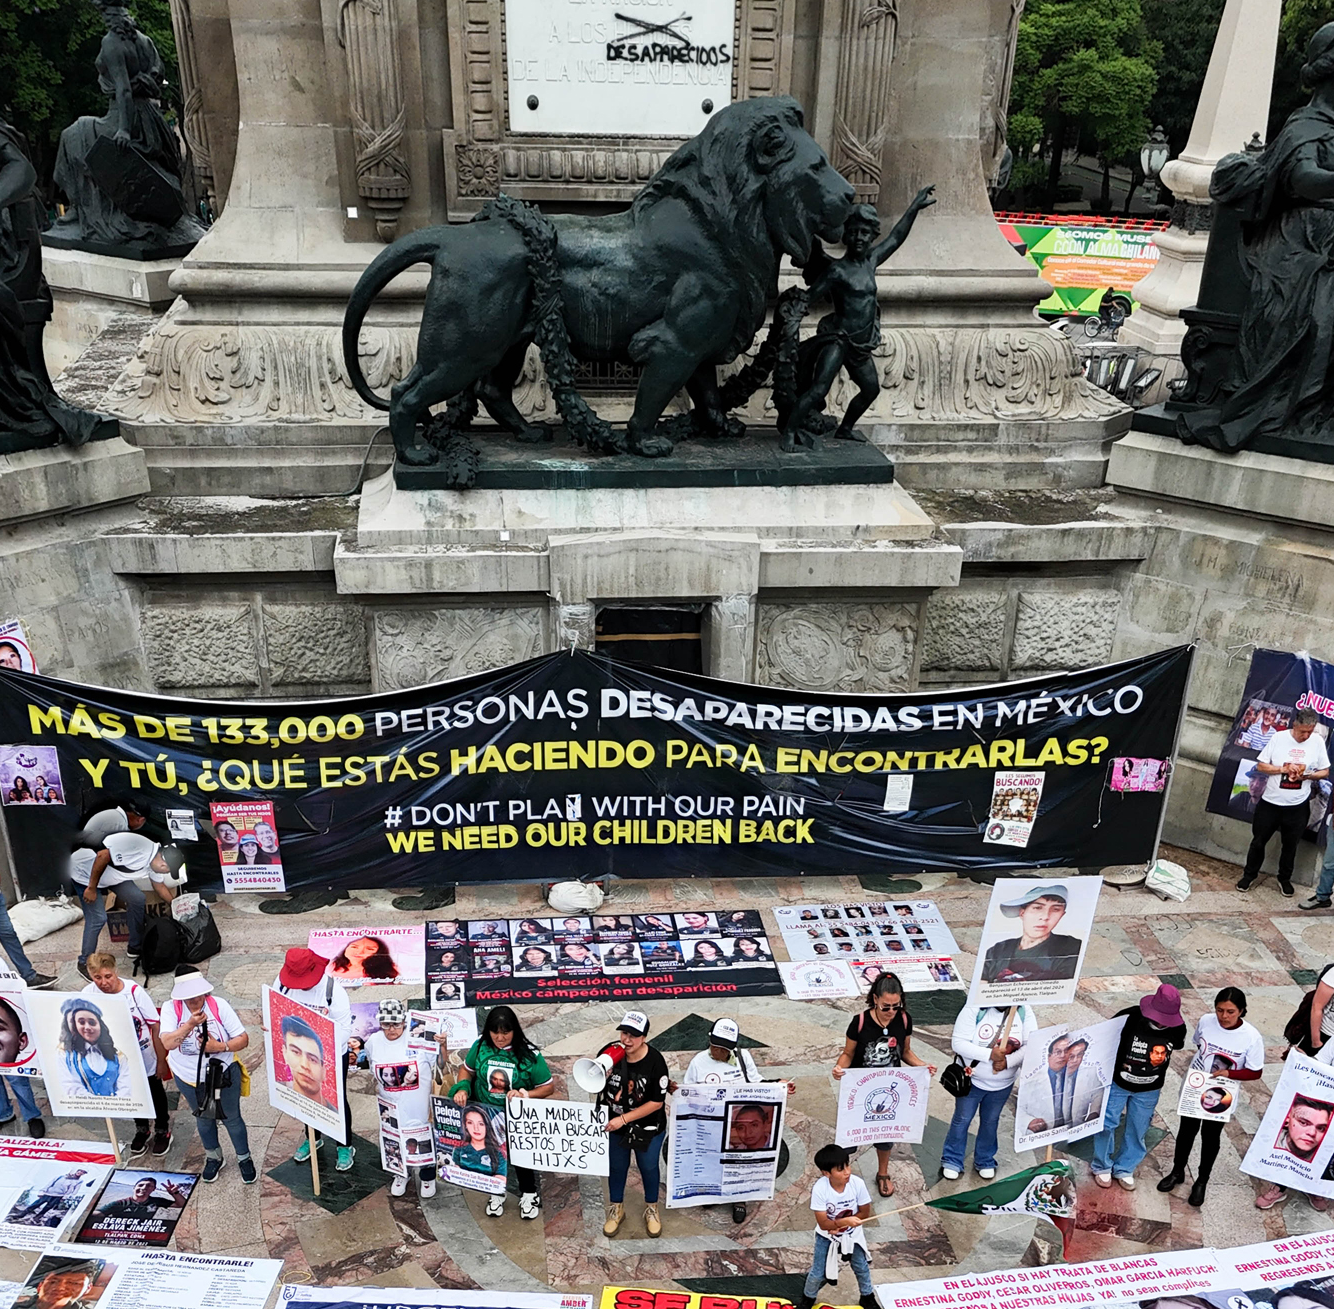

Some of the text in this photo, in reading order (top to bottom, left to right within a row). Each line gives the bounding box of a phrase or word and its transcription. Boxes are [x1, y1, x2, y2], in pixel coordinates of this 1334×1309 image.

[606, 43, 731, 65] DESAPARECIDOS
[29, 686, 1144, 748] MÁS DE 133,000 PERSONAS DESAPARECIDAS EN MÉXICO
[79, 736, 1109, 795] Y TÚ, ¿QUÉ ESTÁS HACIENDO PARA ENCONTRARLAS?
[213, 803, 271, 813] ¡Ayúdanos!
[385, 806, 402, 827] #
[411, 802, 496, 825] DON'T
[596, 796, 667, 817] WITH
[675, 796, 733, 817] OUR
[742, 797, 805, 817] PAIN
[385, 818, 815, 854] WE NEED OUR CHILDREN BACK
[536, 974, 674, 988] Selección femenil
[476, 982, 738, 1000] México campeón en desaparición
[1294, 1062, 1309, 1072] ¡Les
[508, 1100, 605, 1124] UNA MADRE NO
[509, 1121, 608, 1139] DEBERIA BUSCAR
[509, 1137, 605, 1155] RESTOS DE SUS
[533, 1153, 588, 1169] HIJXS
